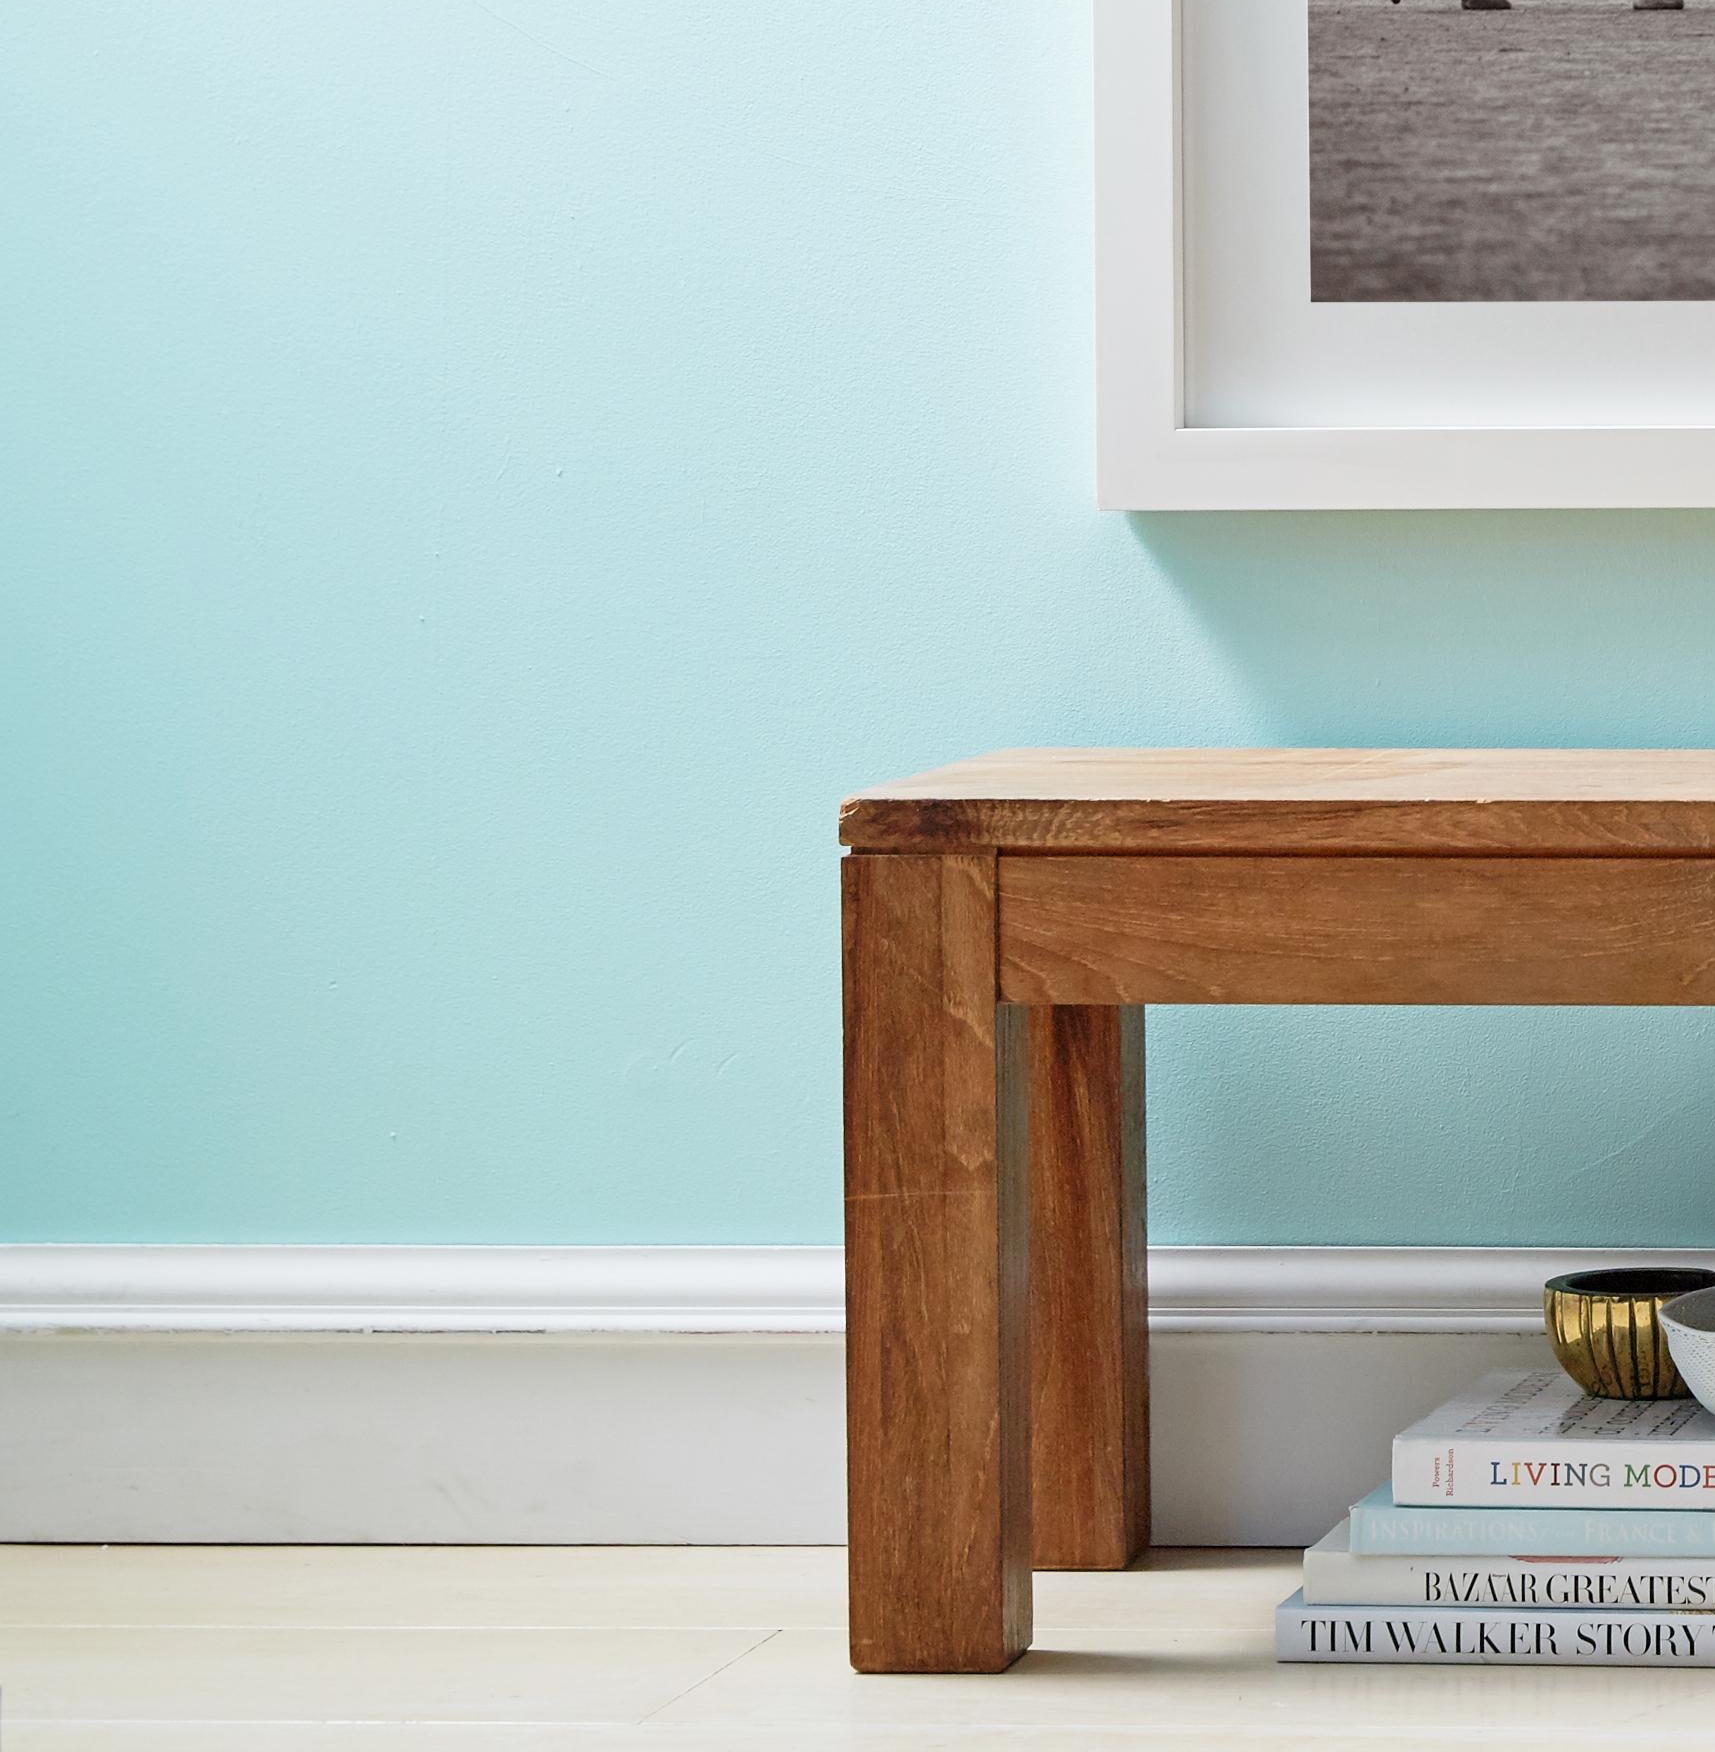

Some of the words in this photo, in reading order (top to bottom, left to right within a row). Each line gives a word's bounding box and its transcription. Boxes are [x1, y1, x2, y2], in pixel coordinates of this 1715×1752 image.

[1432, 1457, 1440, 1488] Powers
[1446, 1448, 1454, 1497] Richardson
[1490, 1461, 1611, 1487] LIVING
[1371, 1519, 1538, 1543] INSPIRATIONS
[1584, 1519, 1677, 1545] FRANCE
[1687, 1523, 1704, 1545] &
[1425, 1571, 1538, 1603] BAZAAR
[1300, 1619, 1373, 1653] TIM
[1383, 1620, 1562, 1656] WALKER
[1576, 1622, 1704, 1657] STORY
